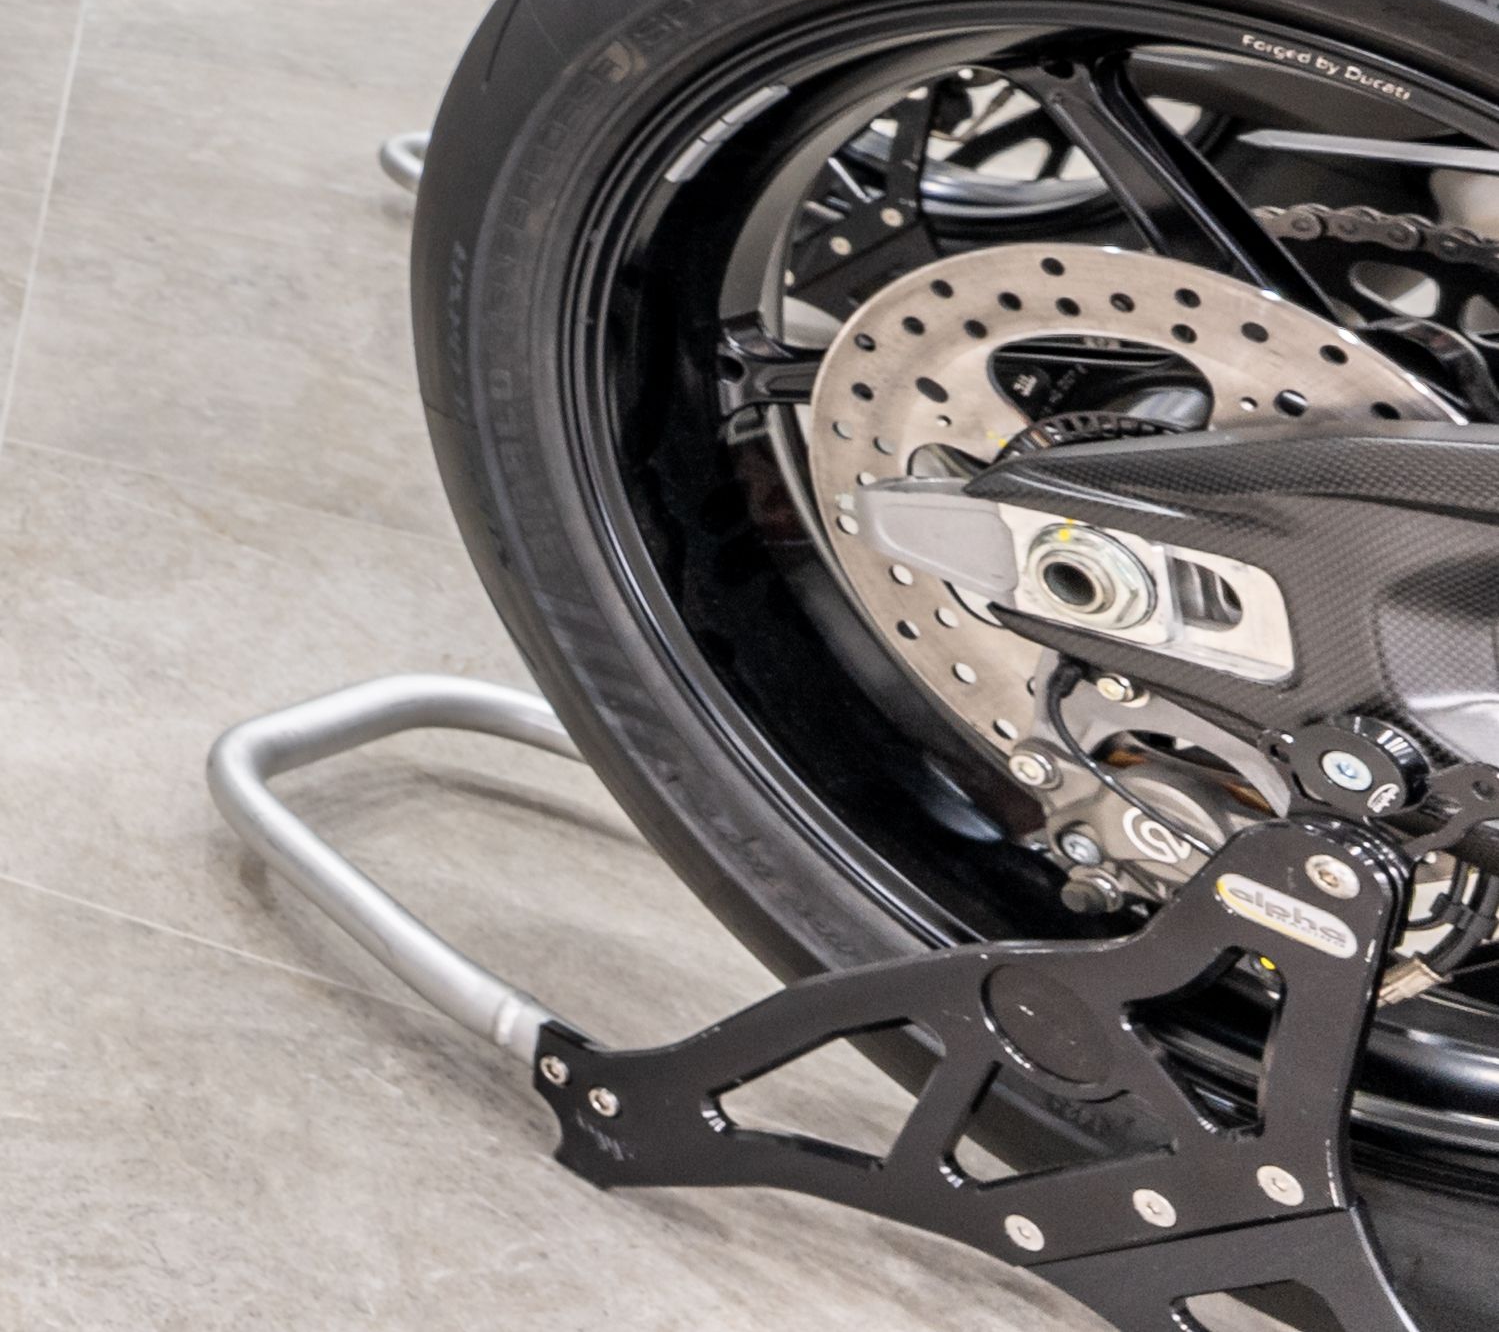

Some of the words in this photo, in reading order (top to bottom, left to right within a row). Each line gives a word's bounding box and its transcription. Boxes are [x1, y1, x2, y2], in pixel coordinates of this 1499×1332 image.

[1242, 34, 1313, 64] Forged
[1315, 56, 1341, 76] by
[1344, 65, 1411, 101] Ducati
